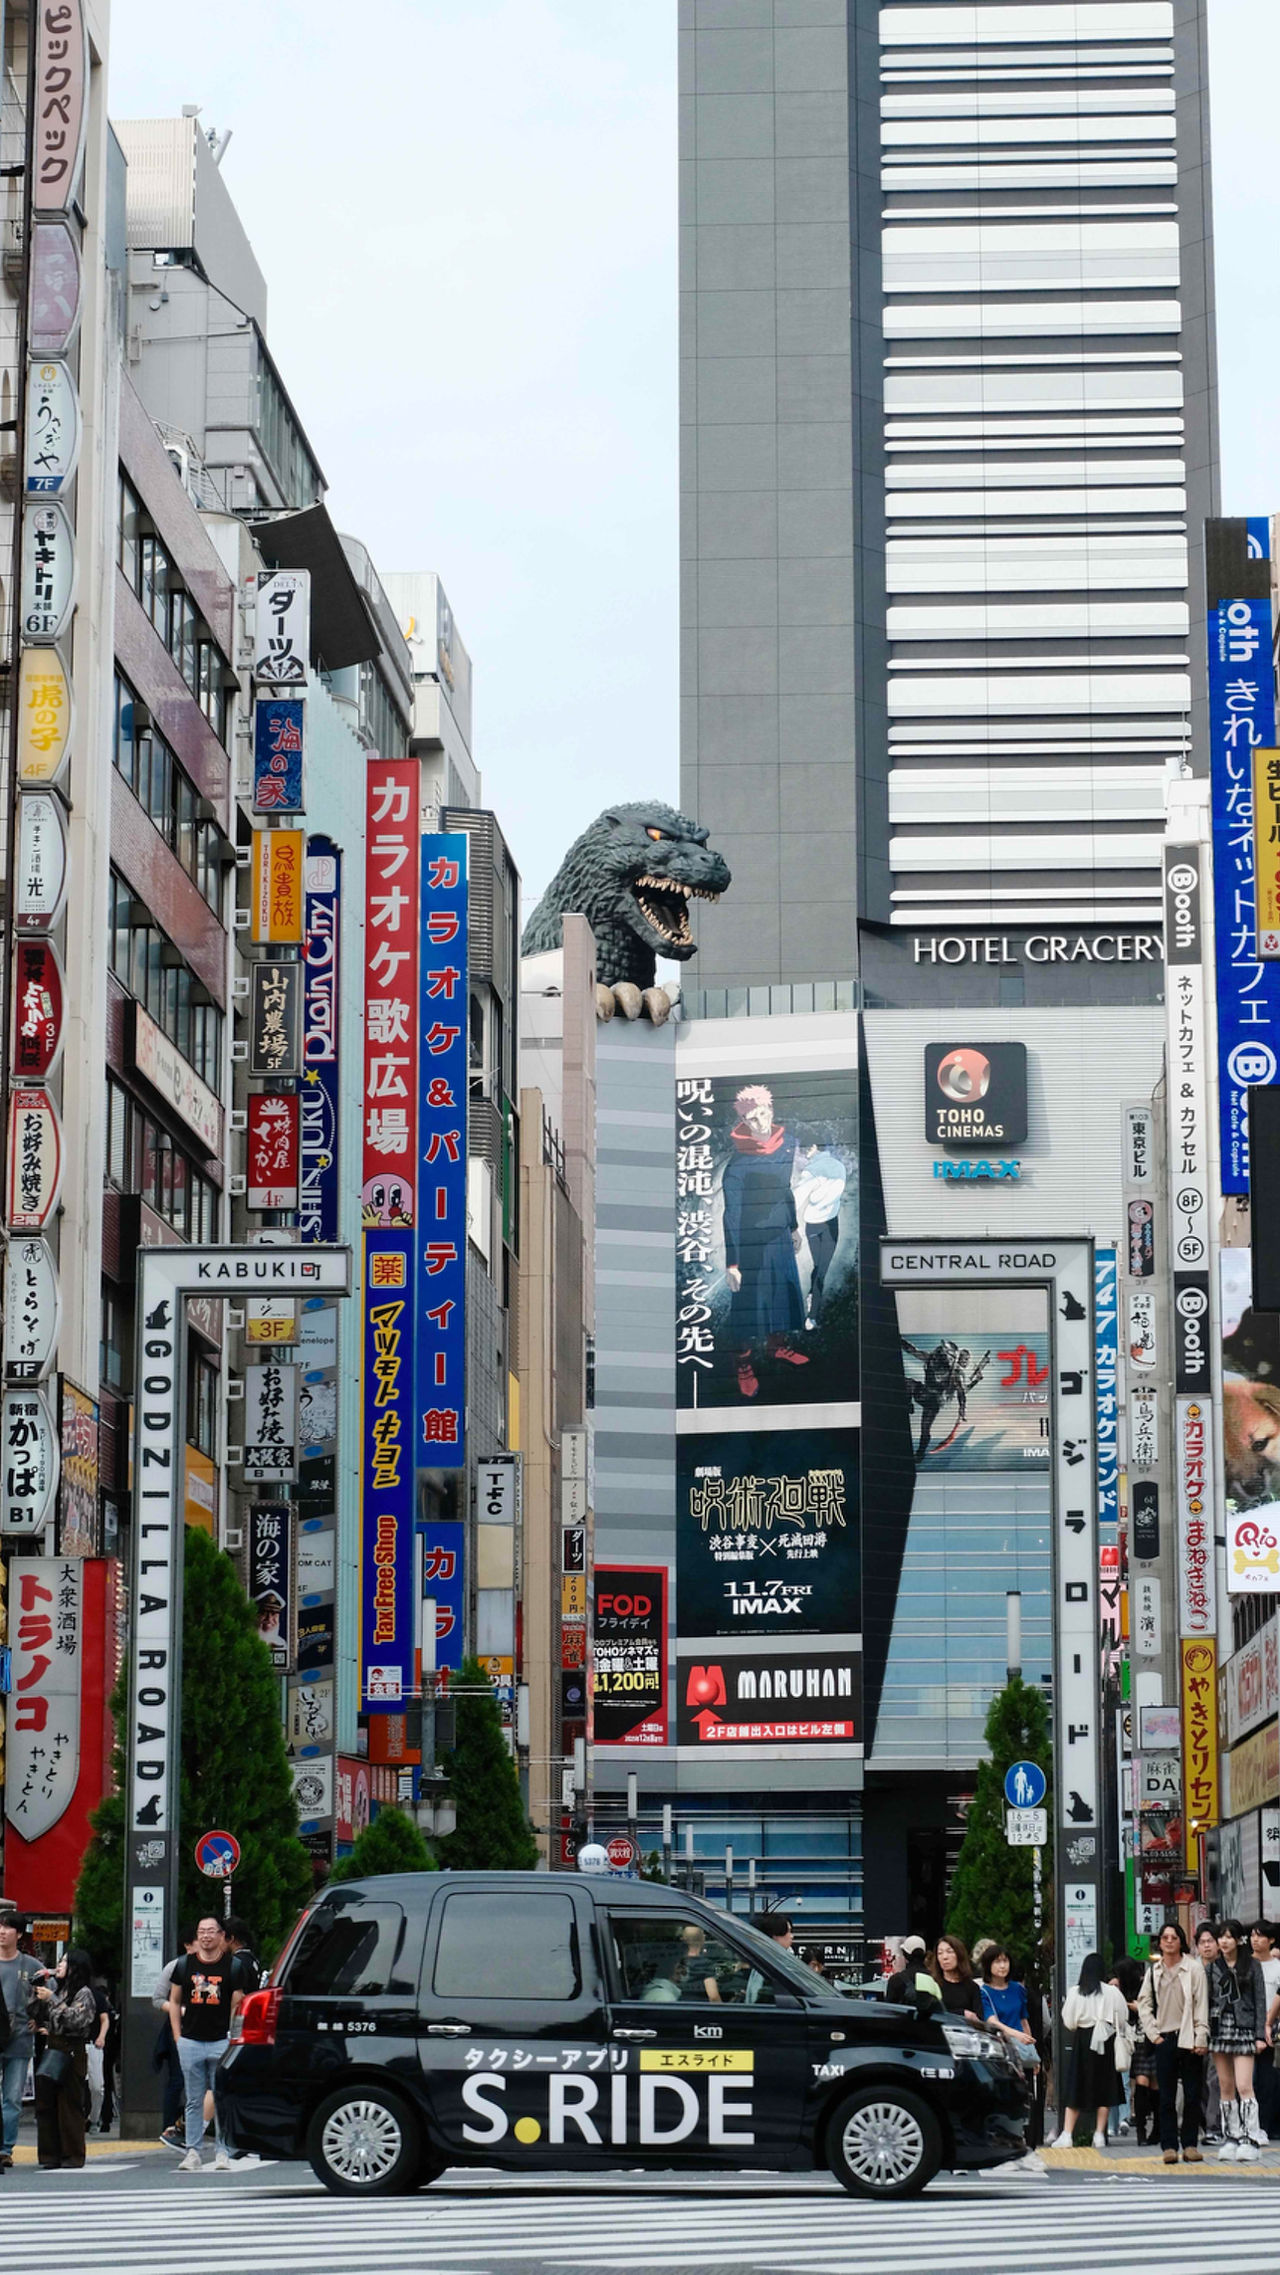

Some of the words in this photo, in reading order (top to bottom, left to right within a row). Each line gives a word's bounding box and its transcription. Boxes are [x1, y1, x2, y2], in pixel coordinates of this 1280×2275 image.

[34, 396, 61, 472] うさぎや
[35, 478, 54, 490] 7F
[34, 530, 56, 601] ヤキトリ
[26, 614, 58, 633] 6F
[269, 590, 296, 662] ダーツ
[1227, 598, 1260, 662] oth
[27, 684, 63, 752] 虎の子
[24, 763, 48, 777] 4F
[256, 718, 301, 807] 海の家
[27, 877, 43, 896] 光
[1166, 863, 1199, 948] Booth
[366, 776, 411, 1155] カラオケ歌広場
[914, 937, 1018, 963] HOTEL
[1025, 935, 1164, 962] GRACERY
[259, 967, 289, 1057] 山内農場
[1177, 975, 1197, 1073] ネットカフェ
[266, 1057, 282, 1069] 5F
[1179, 1081, 1197, 1099] &
[937, 1109, 985, 1123] TOHO
[937, 1125, 1004, 1137] CINEMAS
[1132, 1122, 1148, 1178] 東京ビル
[1179, 1106, 1198, 1175] カプセル
[22, 1112, 44, 1212] お好み焼き
[300, 1089, 334, 1234] SHINJUKU
[933, 1160, 1021, 1178] IMAX
[261, 1189, 284, 1206] 4F
[1182, 1192, 1198, 1208] 8F
[891, 1255, 990, 1270] CENTRAL
[999, 1253, 1055, 1268] ROAD
[1182, 1242, 1198, 1258] 5F
[373, 1256, 403, 1285] 薬
[1094, 1260, 1117, 1334] 747
[260, 1321, 285, 1338] 3F
[302, 1336, 334, 1345] enelope
[1177, 1288, 1208, 1375] Booth
[13, 1363, 36, 1377] 1F
[997, 1344, 1050, 1387] プレ
[9, 1403, 38, 1416] 新宿
[256, 1366, 285, 1444] お好み焼
[370, 1300, 406, 1489] マツモトキヨシ
[1095, 1345, 1120, 1514] カラオケランド
[8, 1418, 39, 1498] かっぱ
[247, 1447, 292, 1467] 大阪家
[1023, 1447, 1050, 1457] IMA
[1185, 1420, 1208, 1501] カラオケ
[141, 1340, 172, 1615] GODZILLA
[694, 1466, 722, 1477] 劇場版
[486, 1473, 504, 1516] TFC
[690, 1469, 847, 1531] 呪術廻戦
[10, 1507, 34, 1523] B1
[255, 1513, 281, 1586] 海の家
[375, 1515, 398, 1565] Shop
[572, 1531, 583, 1563] ダーツ
[709, 1533, 759, 1550] 渋谷事変
[1235, 1521, 1278, 1549] Rio
[786, 1548, 819, 1559] 先行上映
[1058, 1369, 1091, 1745] ゴジラロード
[374, 1566, 396, 1603] Free
[723, 1580, 783, 1597] 11.7
[781, 1585, 814, 1596] FRI
[1186, 1520, 1209, 1633] まねきねこ
[56, 1563, 79, 1656] 大衆酒場
[597, 1593, 652, 1616] FOD
[732, 1598, 803, 1615] IMAX
[373, 1603, 397, 1644] Tax
[598, 1617, 650, 1629] フライデイ
[14, 1573, 54, 1733] トラノコ
[564, 1633, 583, 1662] 麻雀
[738, 1668, 852, 1700] MARUHAN
[138, 1650, 167, 1781] ROAD
[15, 1745, 46, 1815] やきとん
[41, 1733, 69, 1800] やきとり
[347, 2021, 377, 2033] 5376
[464, 2048, 629, 2069] タクシーアプリ
[660, 2054, 733, 2067] エスライド
[812, 2064, 845, 2077] TAXI
[461, 2072, 755, 2145] S.RIDE
